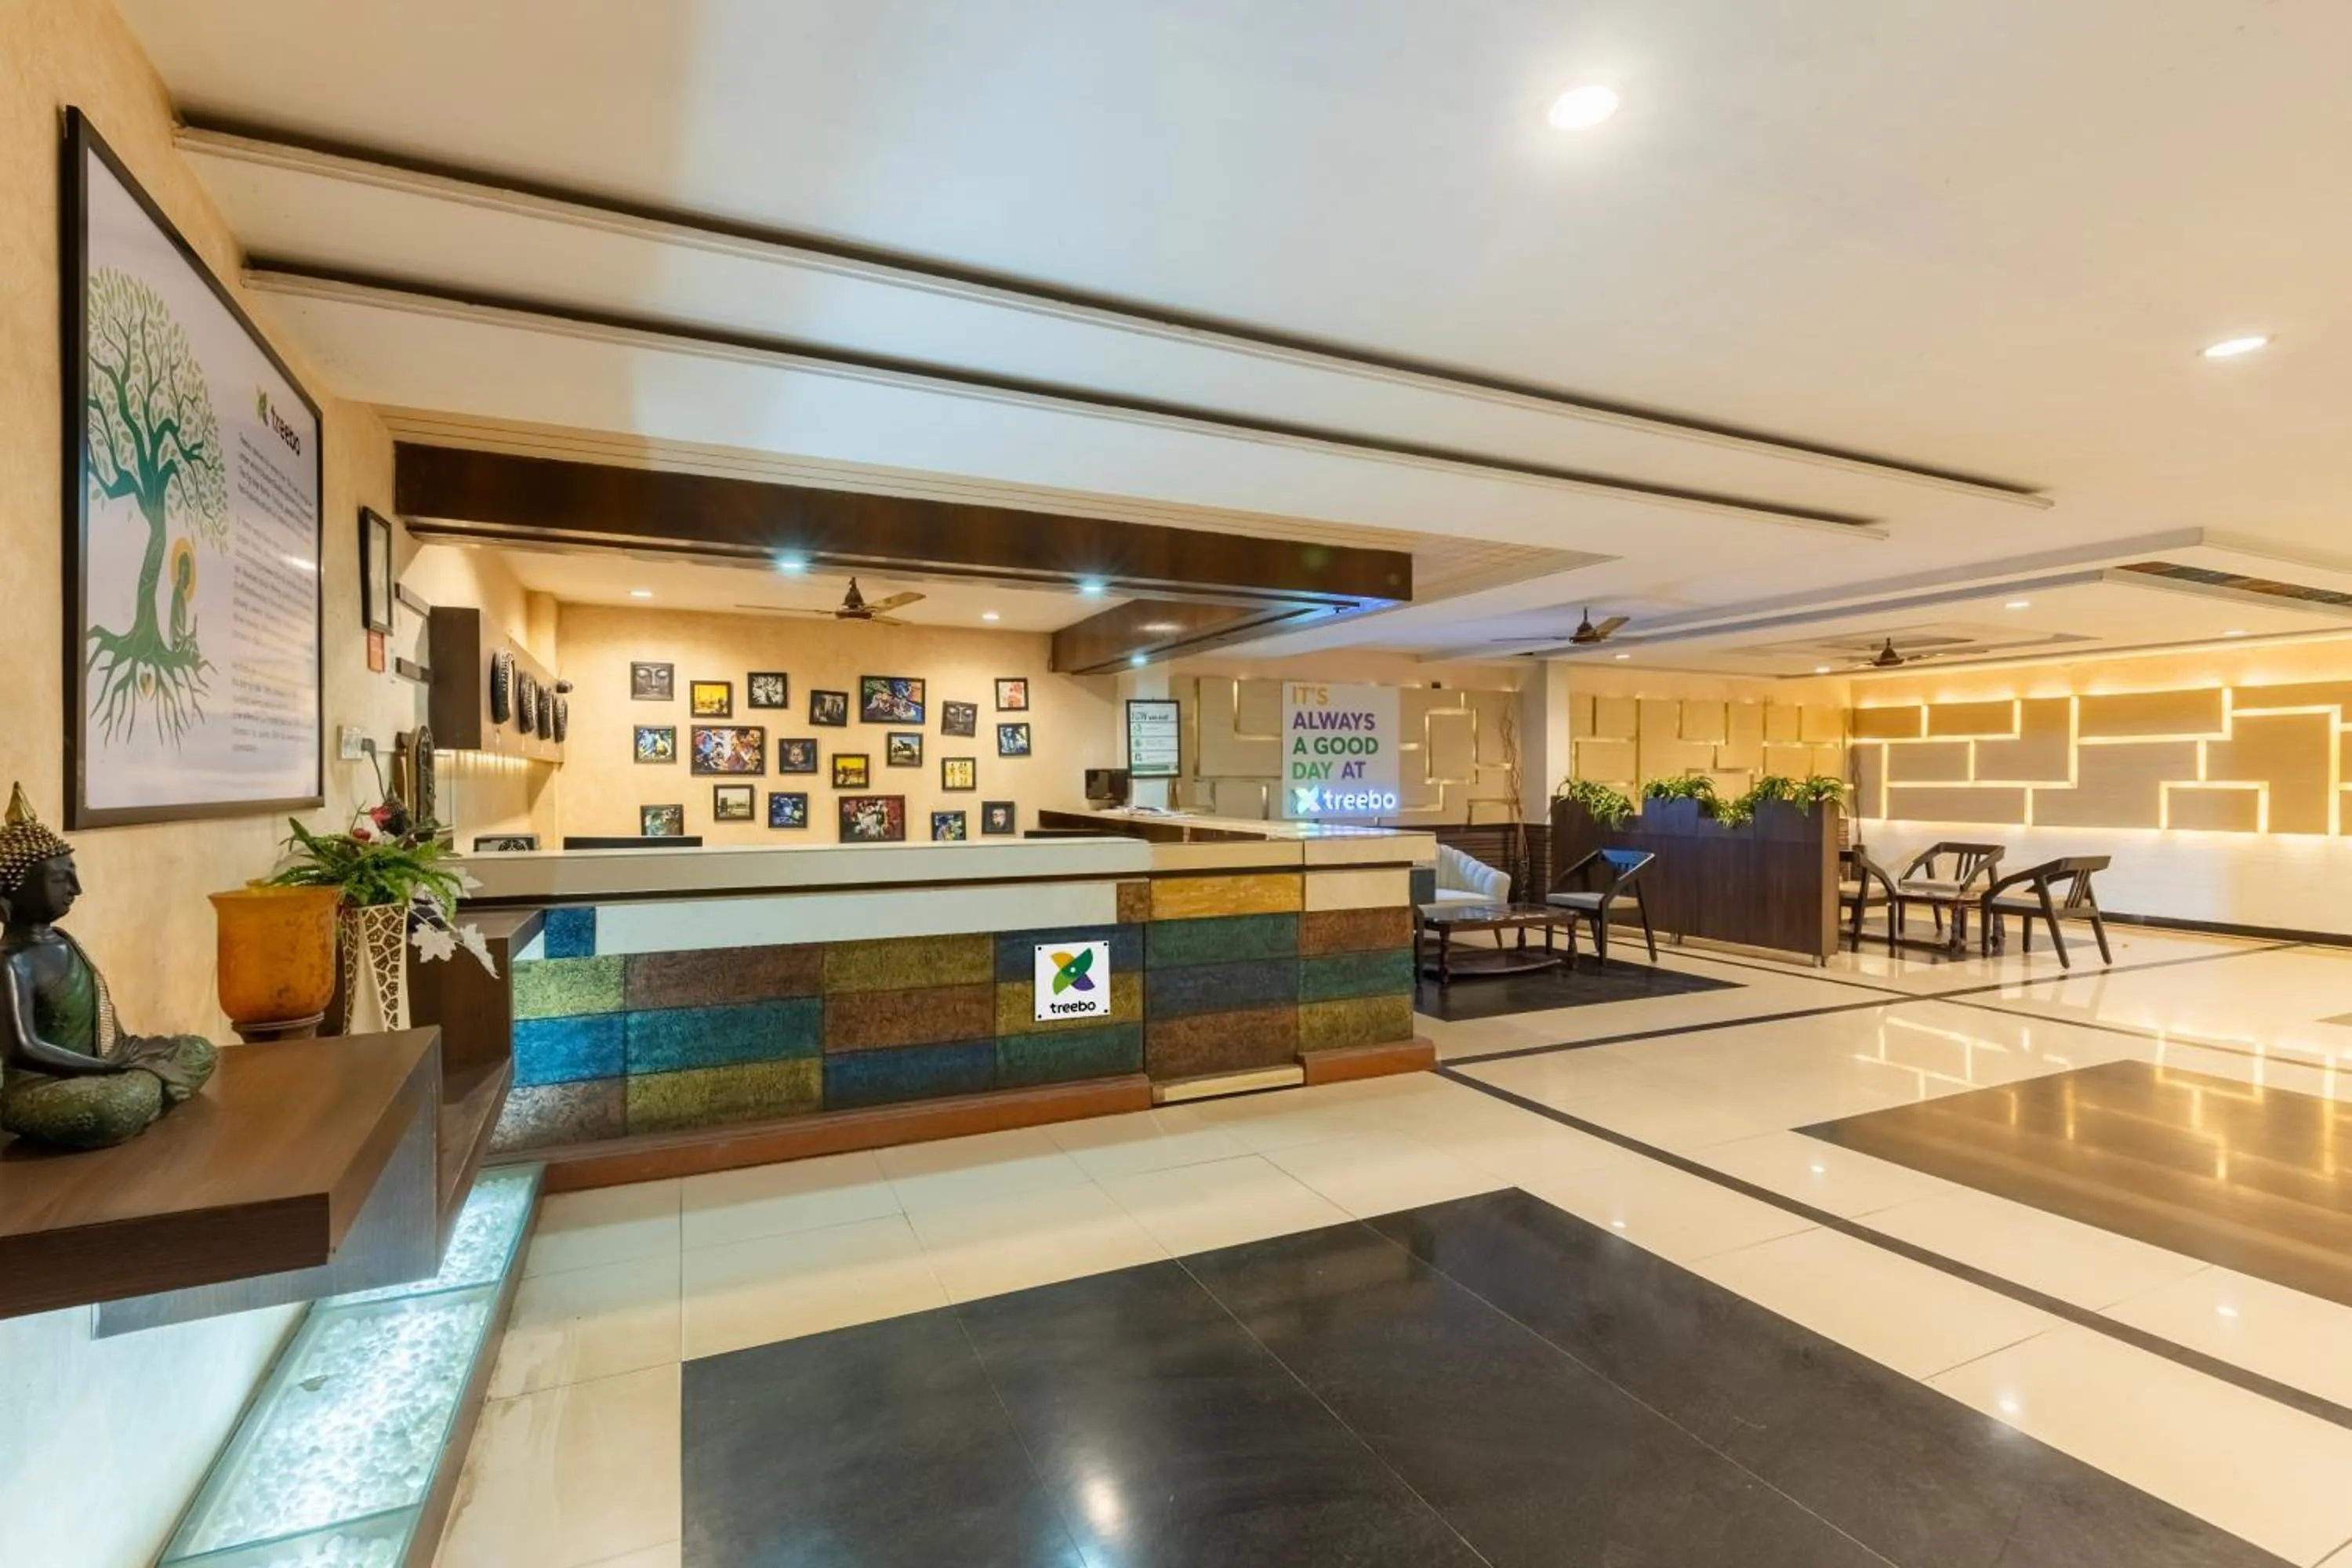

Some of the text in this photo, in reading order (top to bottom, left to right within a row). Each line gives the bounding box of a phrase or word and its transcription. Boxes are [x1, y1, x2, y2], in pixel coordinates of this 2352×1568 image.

[1292, 686, 1329, 705] IT'S
[1293, 711, 1375, 730] ALWAYS
[1292, 737, 1378, 754] A GOOD
[1292, 761, 1367, 779] DAY AT
[1323, 789, 1396, 810] treebo
[1050, 1000, 1096, 1013] treebo
